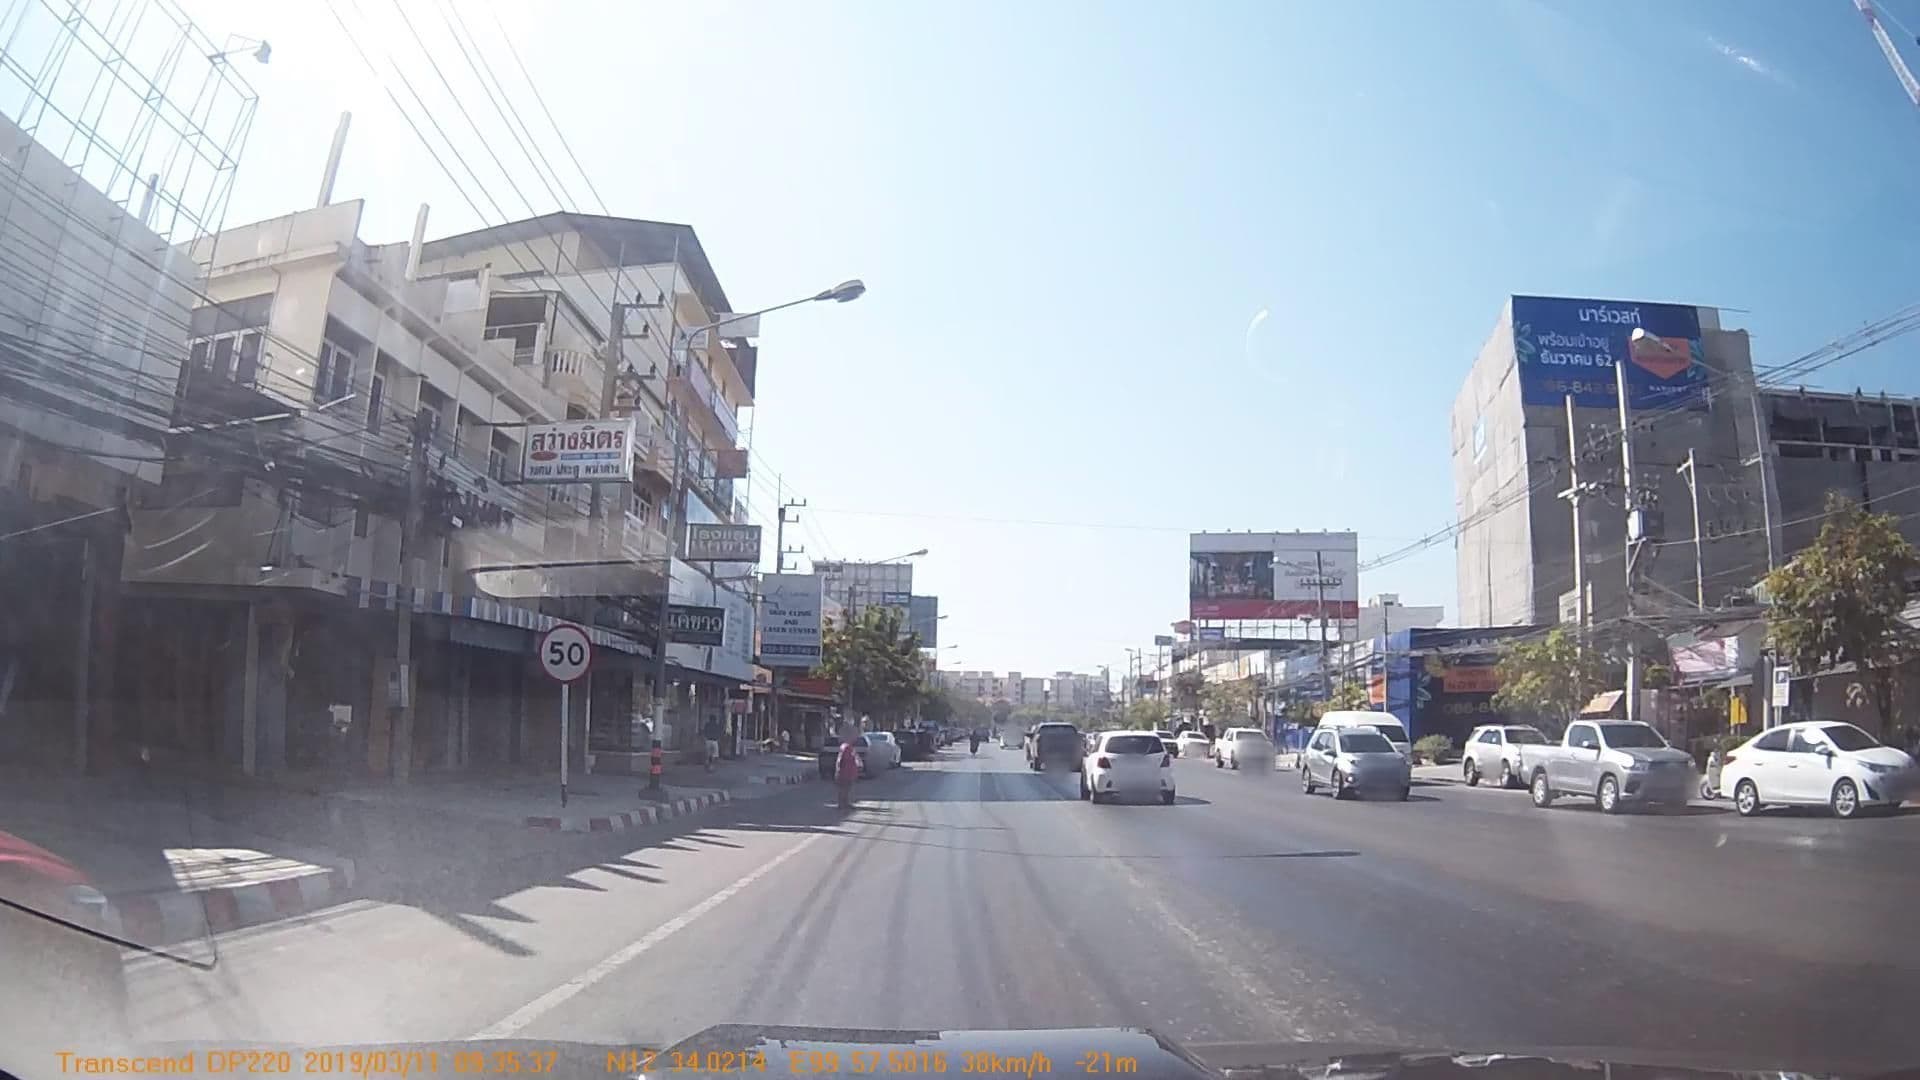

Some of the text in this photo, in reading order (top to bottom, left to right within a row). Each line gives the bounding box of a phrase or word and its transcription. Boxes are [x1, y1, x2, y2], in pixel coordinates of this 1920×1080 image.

[1541, 349, 1613, 367] ธันวาคม 62
[531, 425, 624, 451] สว่างมิตร
[550, 641, 584, 666] 50
